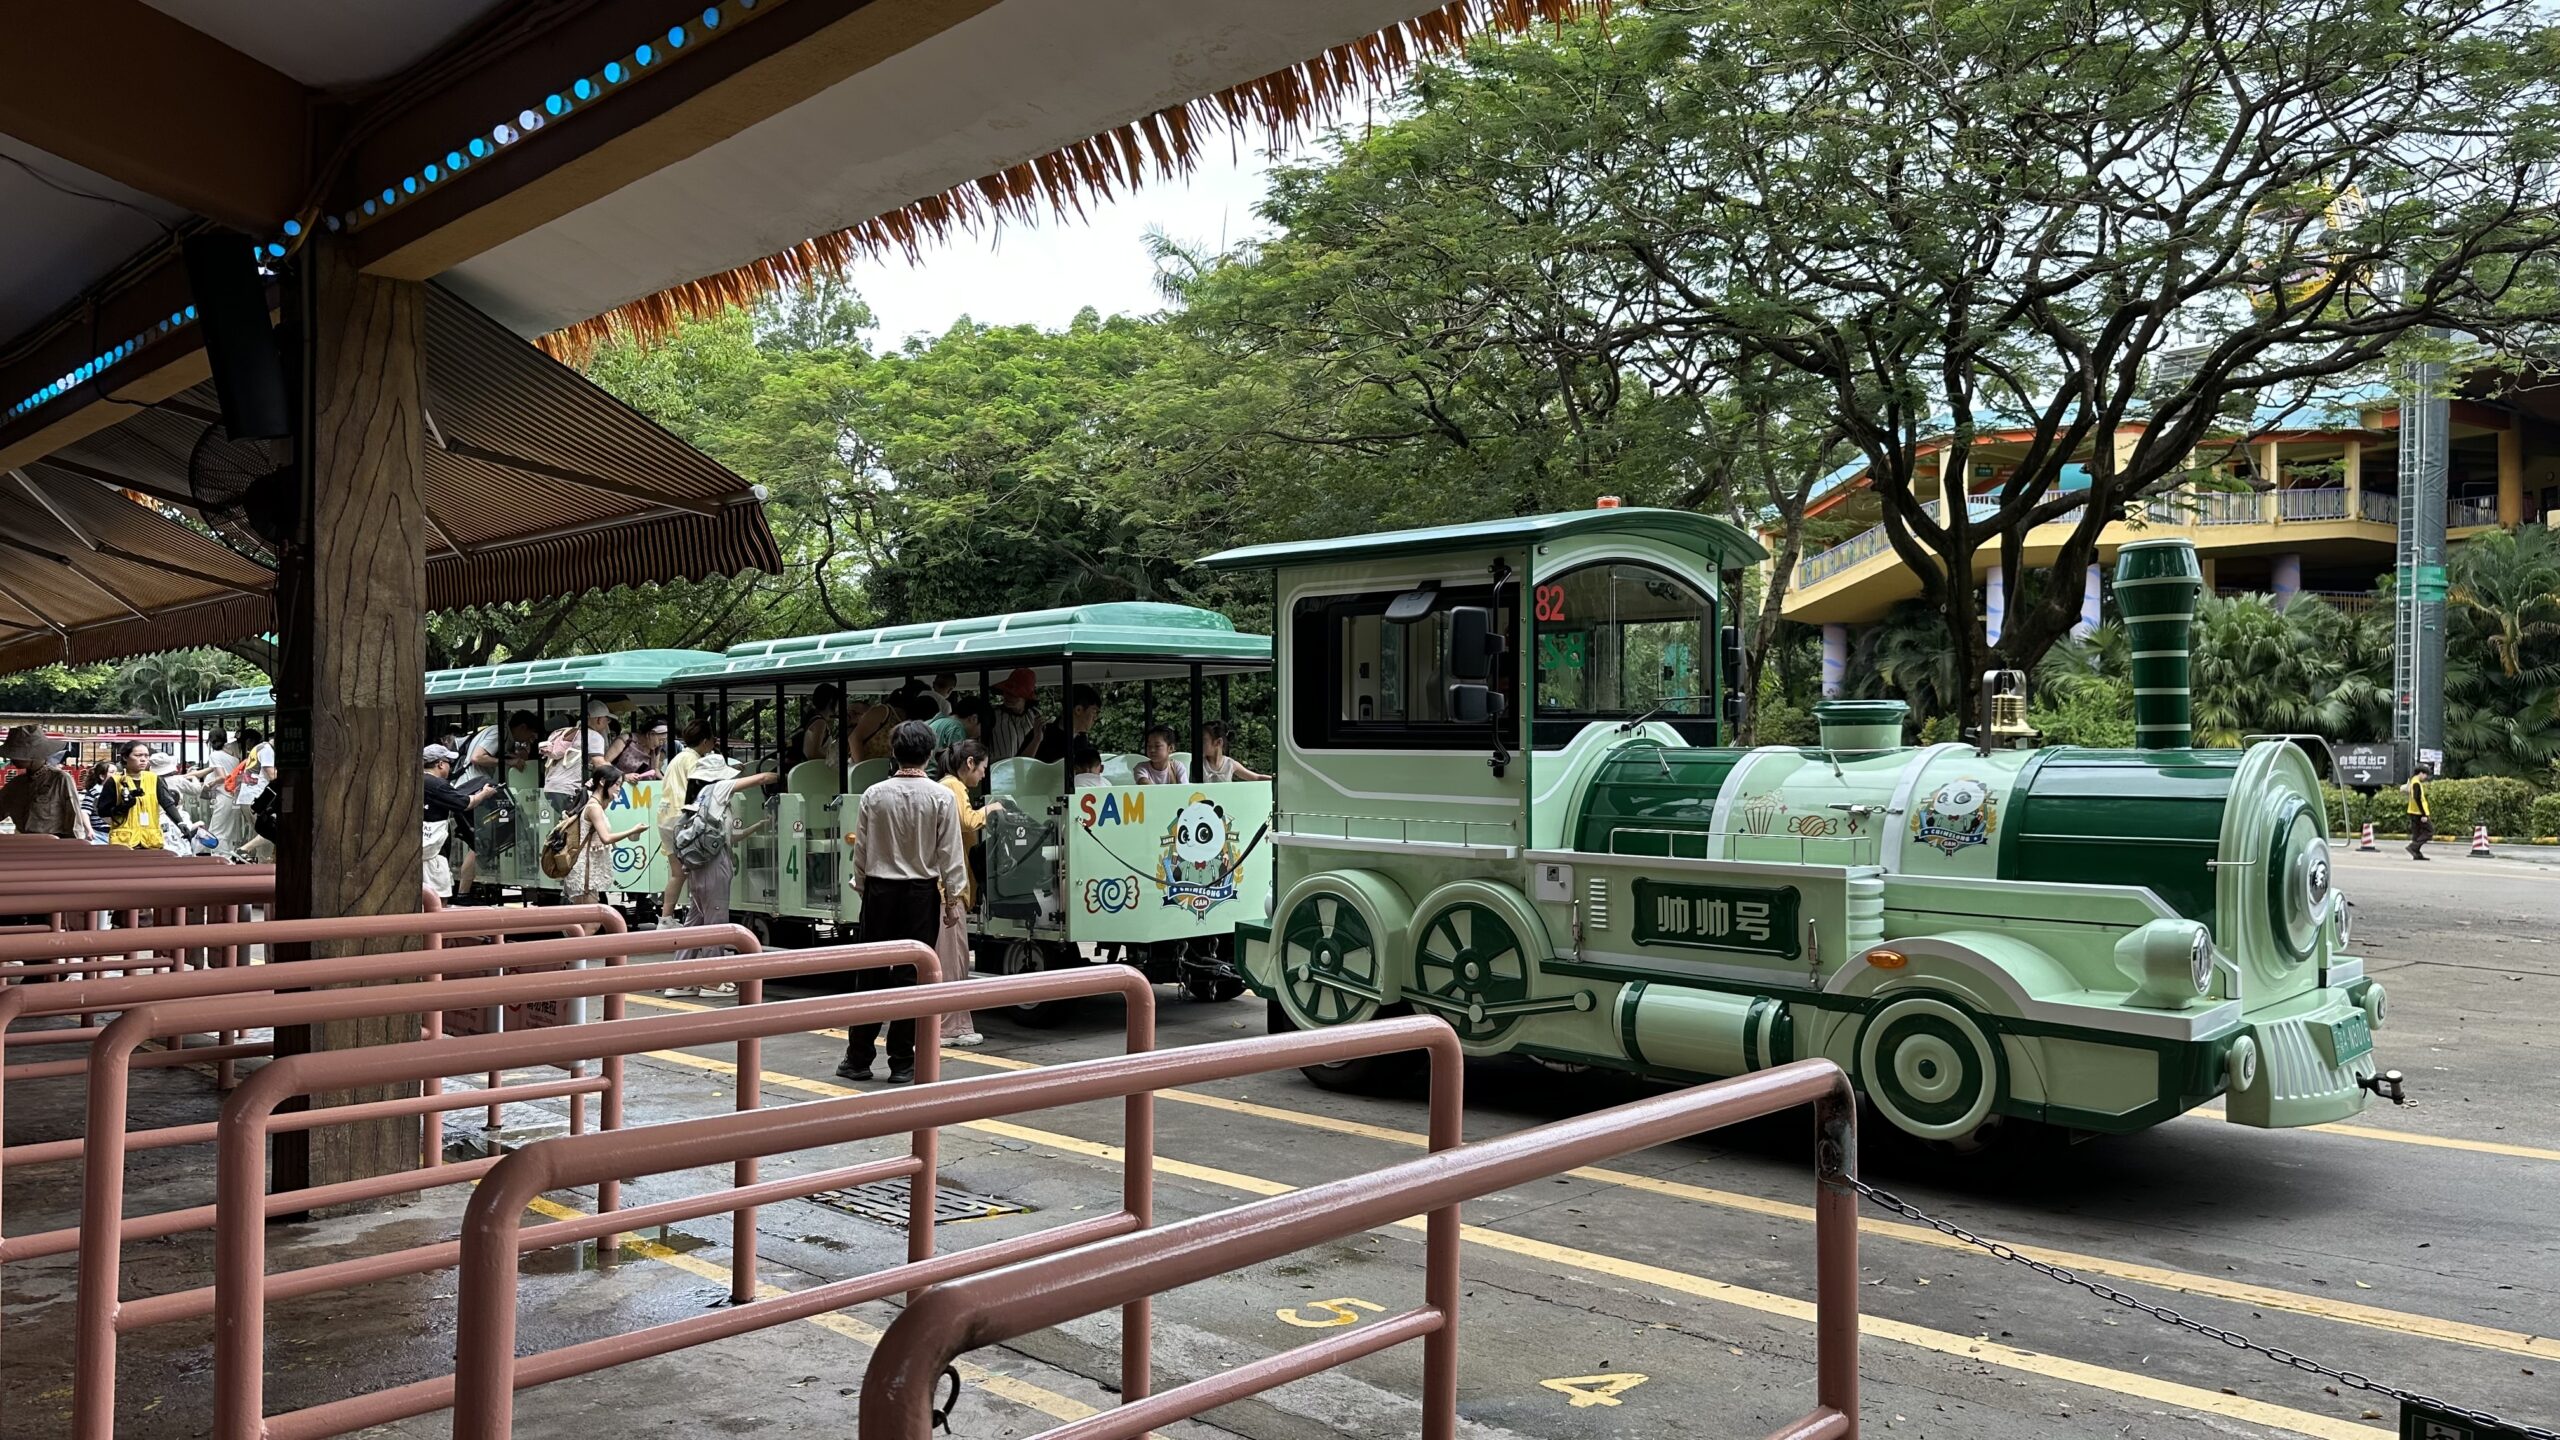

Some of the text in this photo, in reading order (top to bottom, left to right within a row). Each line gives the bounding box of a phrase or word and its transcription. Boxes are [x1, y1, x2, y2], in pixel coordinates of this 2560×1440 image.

[1536, 585, 1565, 621] 82
[2339, 756, 2386, 766] 自驾区出口
[610, 785, 651, 811] AM
[1080, 792, 1145, 828] SAM
[1930, 829, 1970, 842] CHIMELONG
[786, 844, 798, 881] 4
[1194, 899, 1208, 907] SAM
[1657, 896, 1770, 941] 帅帅号
[1276, 1297, 1387, 1328] 5
[1539, 1373, 1650, 1408] 4
